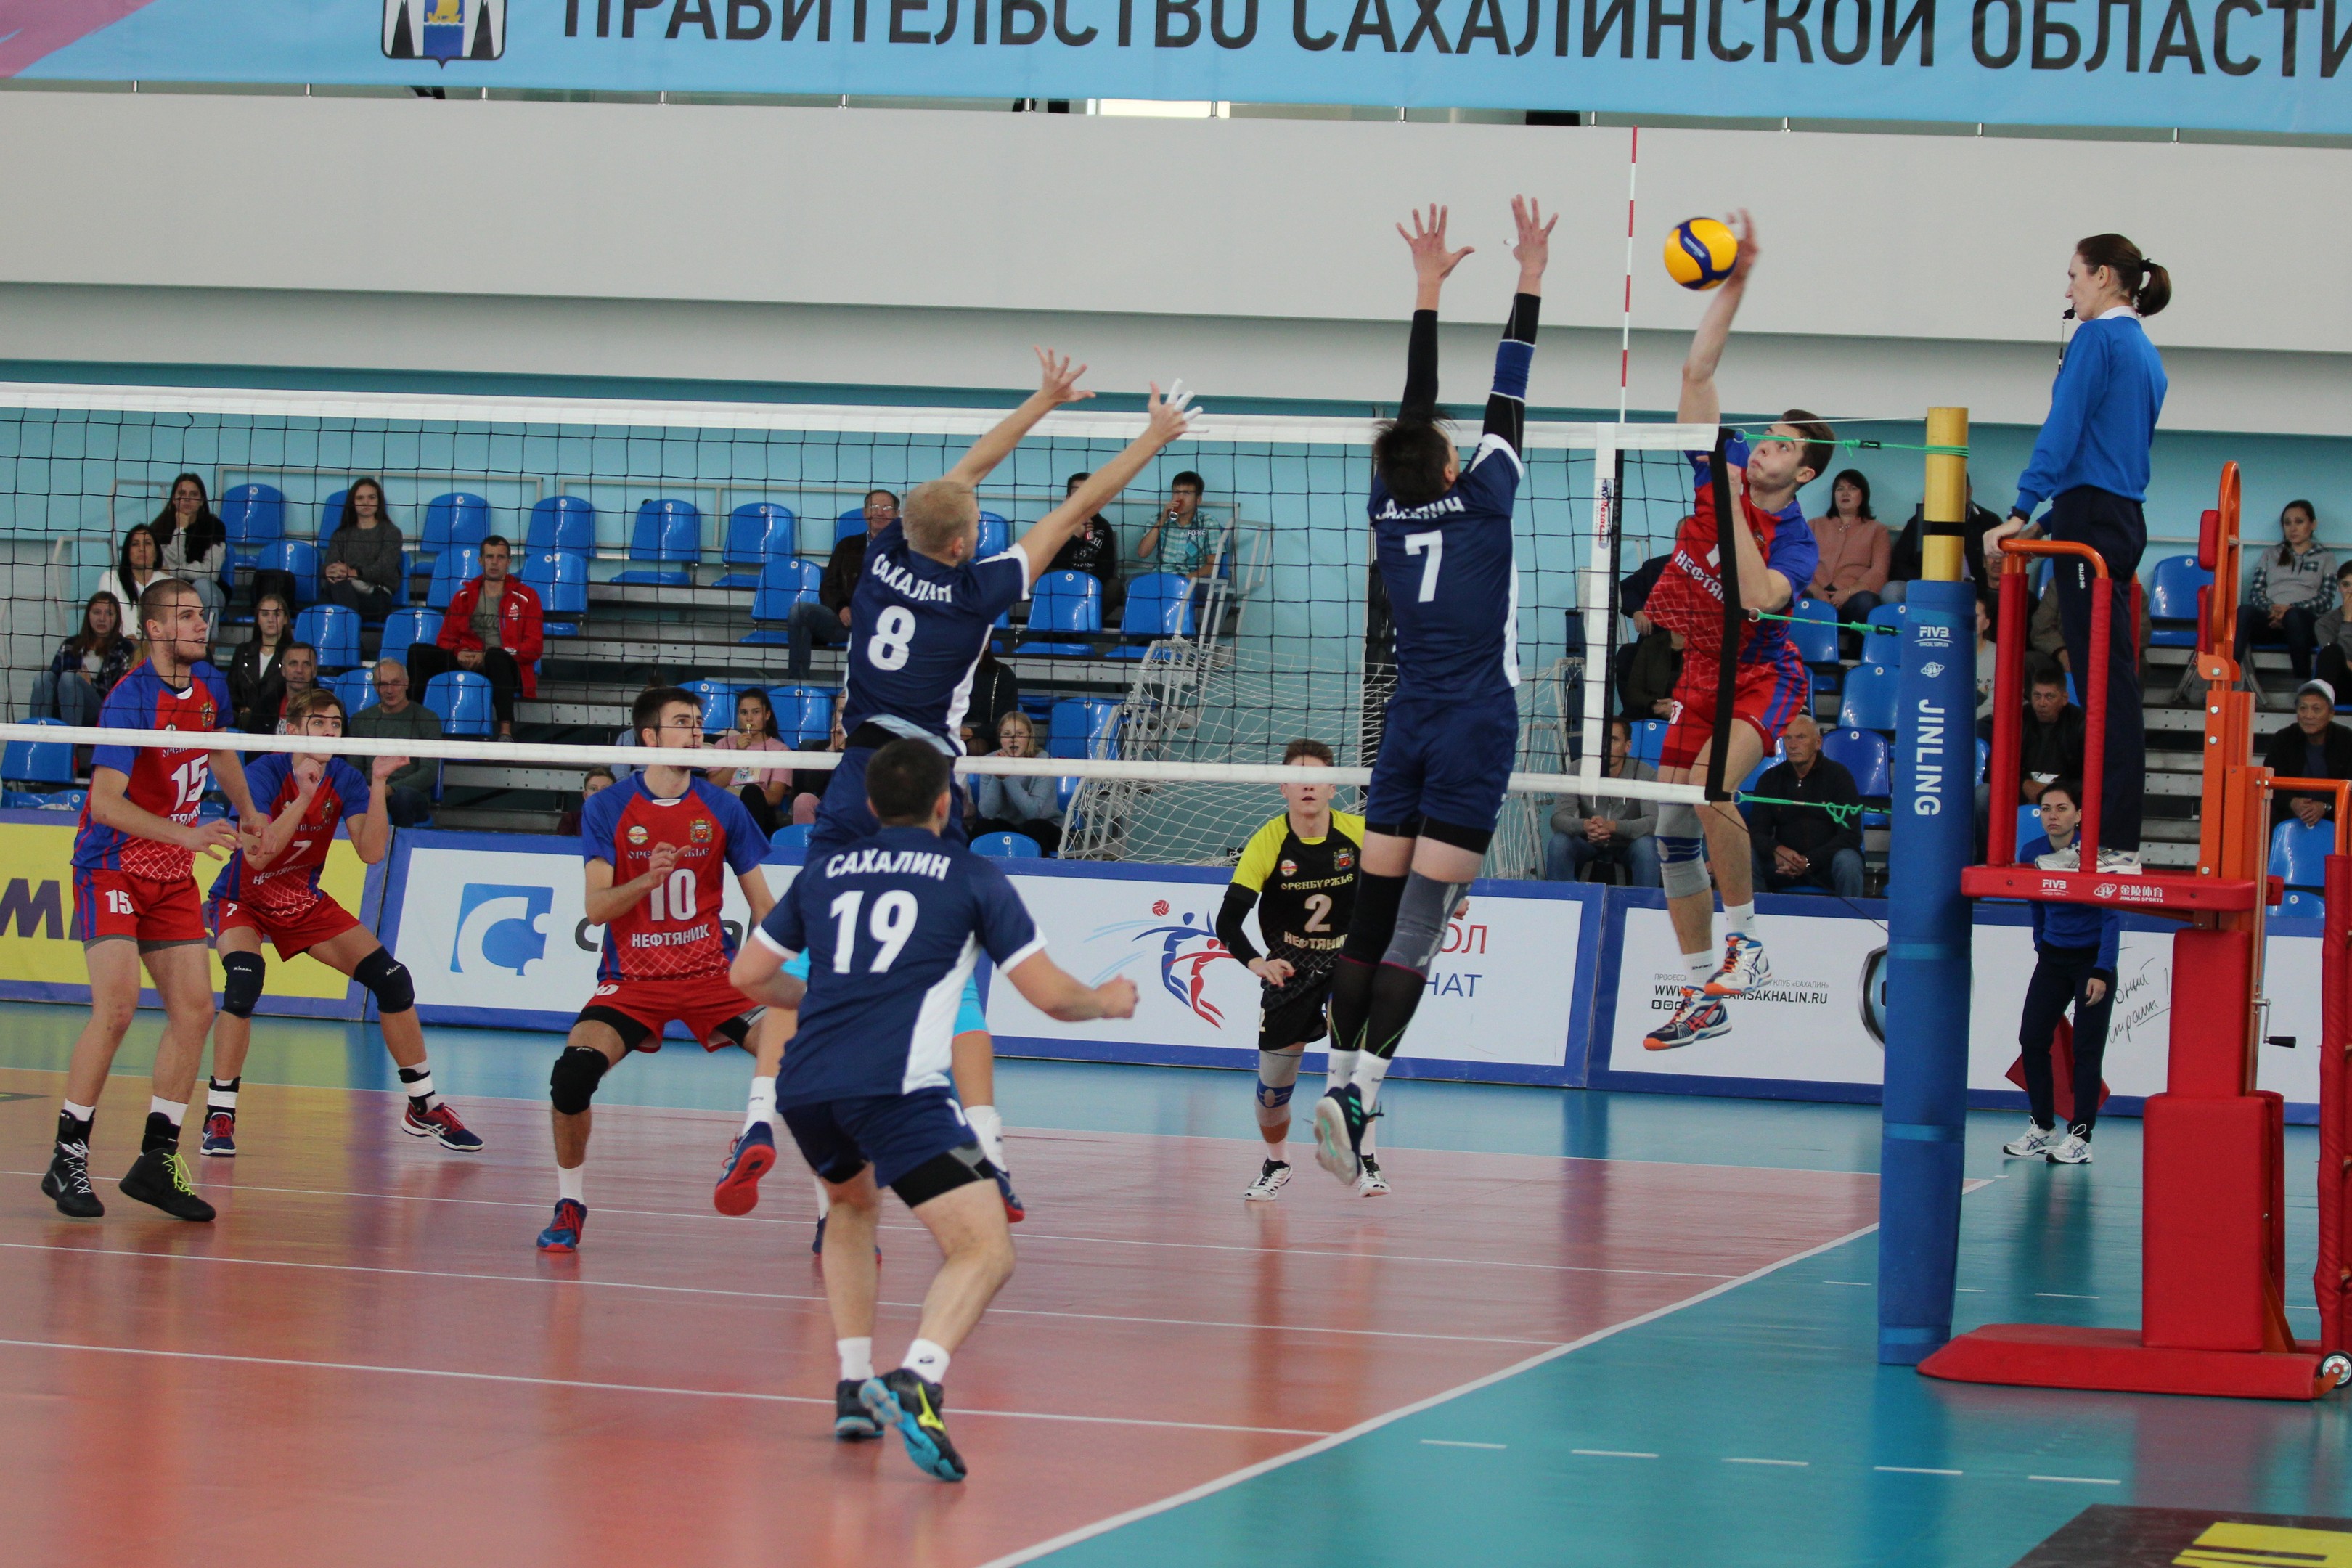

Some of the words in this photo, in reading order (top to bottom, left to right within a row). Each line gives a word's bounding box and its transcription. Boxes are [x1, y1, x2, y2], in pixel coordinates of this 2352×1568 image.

[872, 553, 952, 603] САХАЛИН
[1405, 529, 1443, 603] 7
[1673, 550, 1726, 604] НЕФТЯ
[867, 605, 916, 671] 8
[1919, 626, 1950, 638] FIVB
[1914, 698, 1945, 816] JINLING
[171, 753, 209, 812] 15
[283, 840, 313, 865] 7
[825, 848, 952, 881] САХАЛИН
[650, 867, 697, 921] 10
[1281, 873, 1354, 891] ОРЕНБУРЖЬЕ
[2042, 878, 2067, 889] FIVB
[105, 889, 134, 915] 15
[226, 902, 238, 917] 7
[1304, 894, 1332, 933] 2
[632, 923, 710, 948] НЕФТЯНИК
[829, 889, 918, 974] 19
[1283, 931, 1349, 950] НЕФТЯНИ
[1440, 923, 1487, 954] ОЛ
[1426, 973, 1483, 997] НАТ
[1654, 973, 1686, 982] ПРОФЕСС
